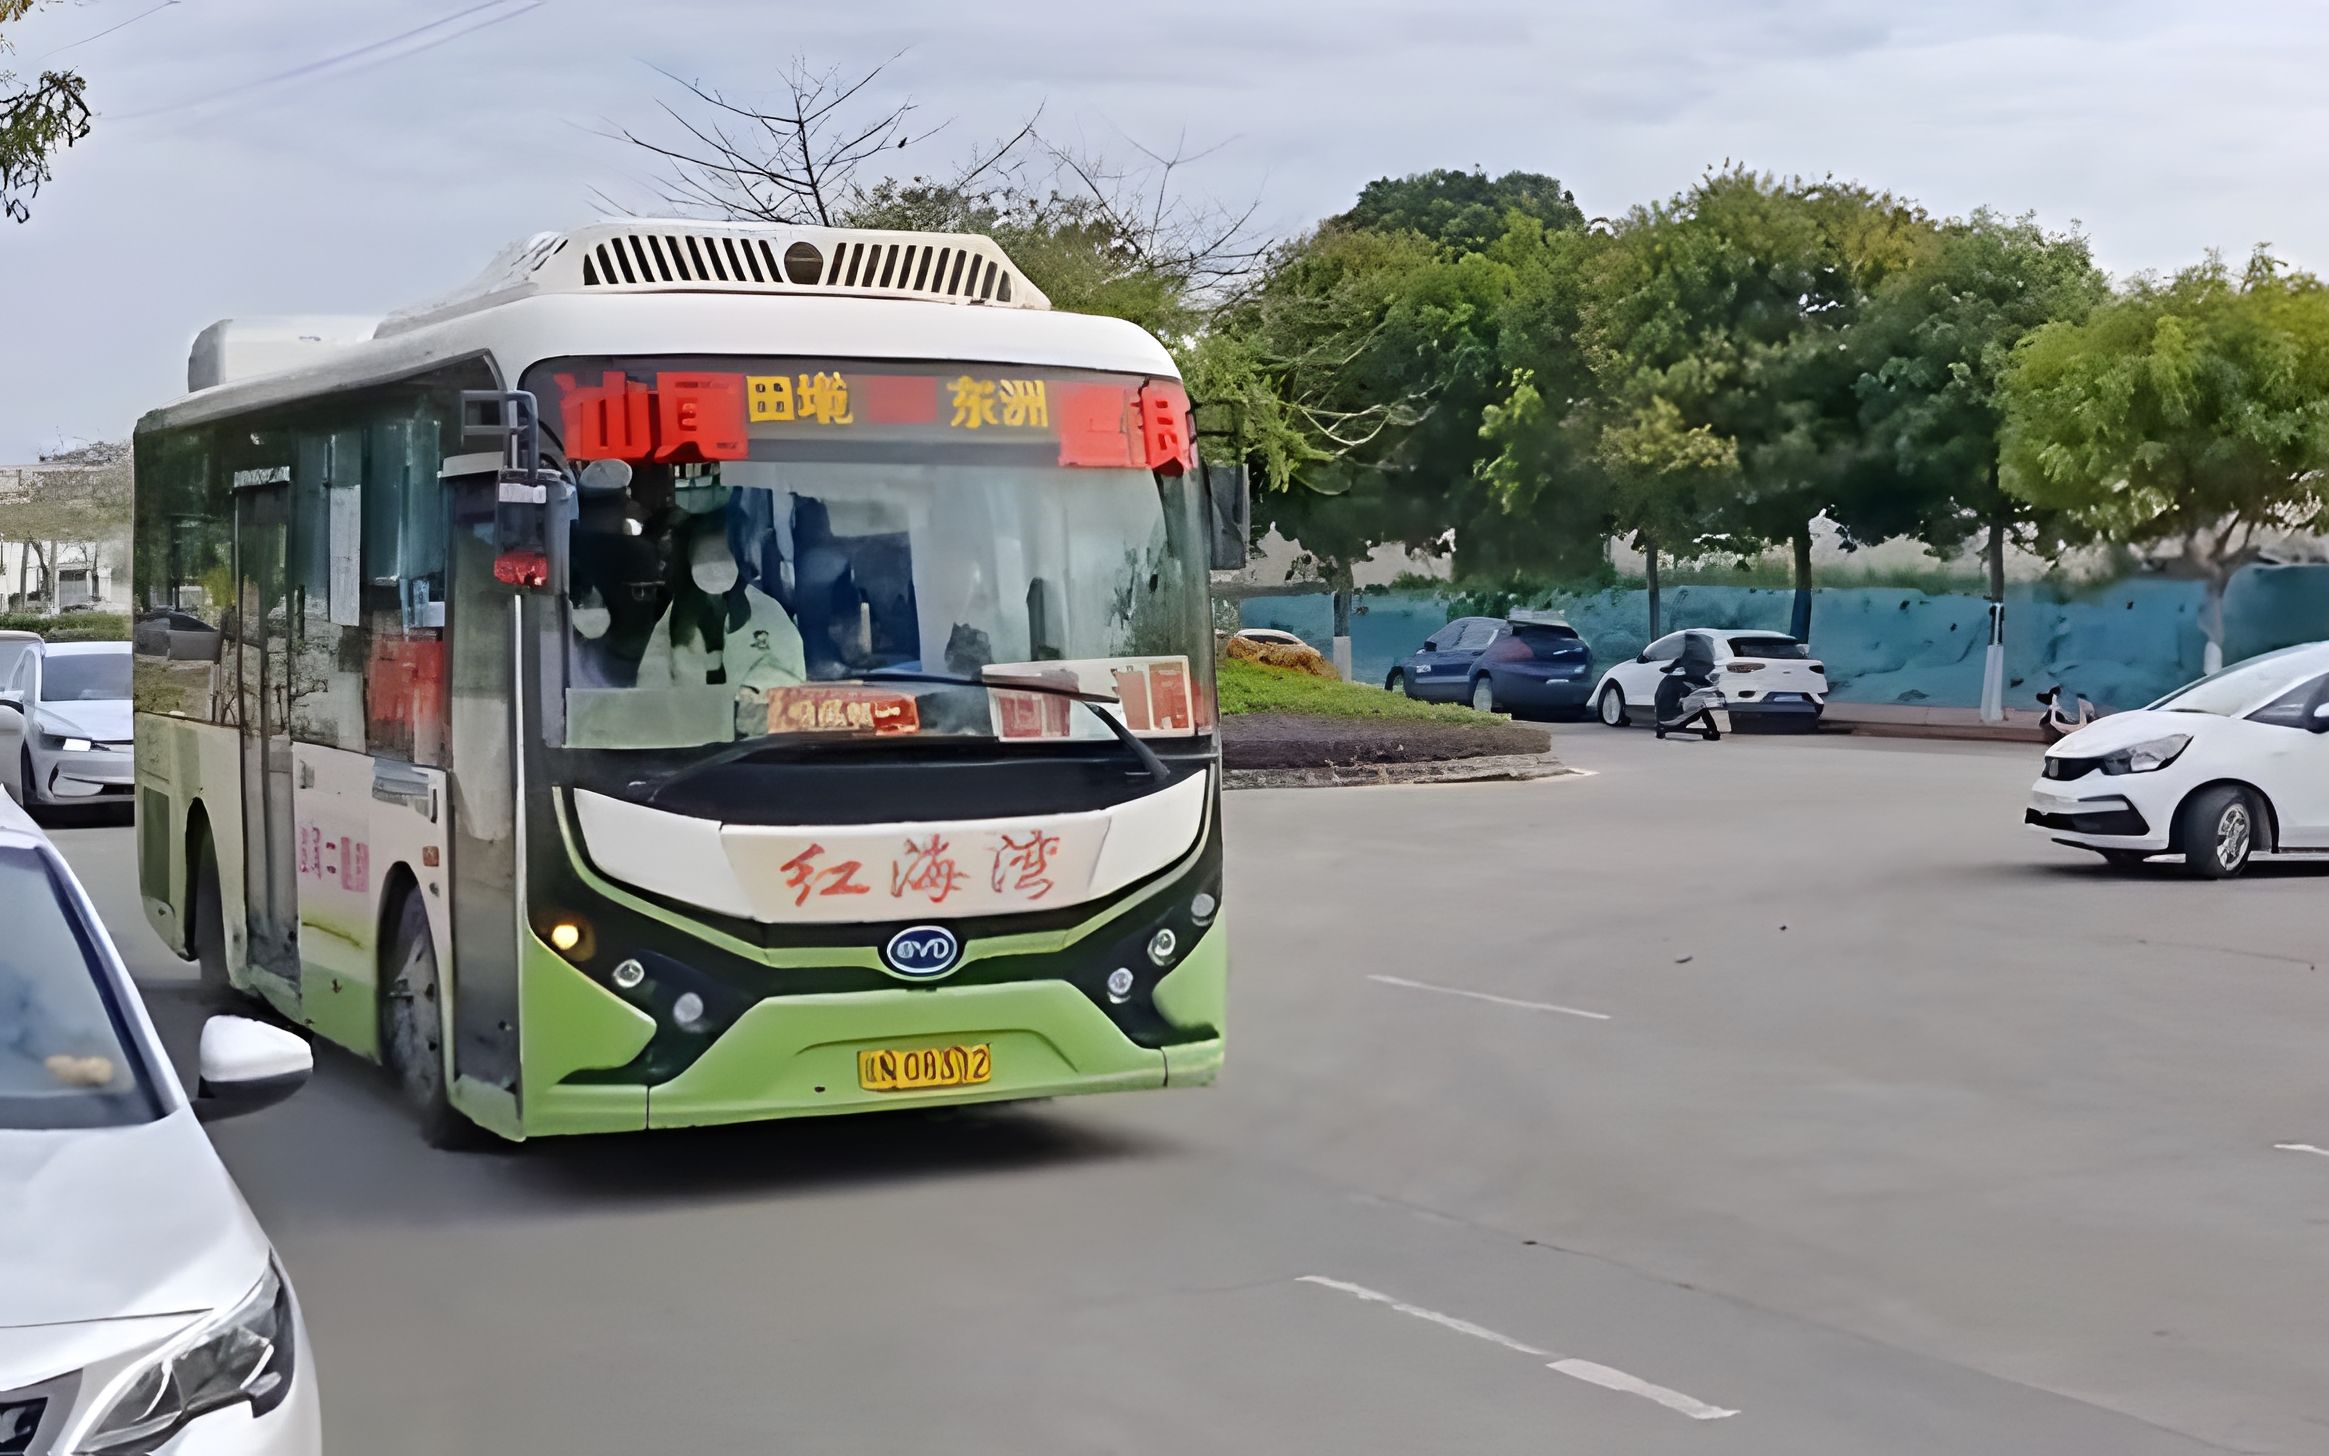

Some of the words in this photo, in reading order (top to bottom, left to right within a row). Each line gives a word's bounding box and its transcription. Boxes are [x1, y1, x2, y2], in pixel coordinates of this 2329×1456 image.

[946, 375, 1048, 428] 东洲
[779, 828, 1061, 907] 红海湾
[896, 937, 949, 959] BYD
